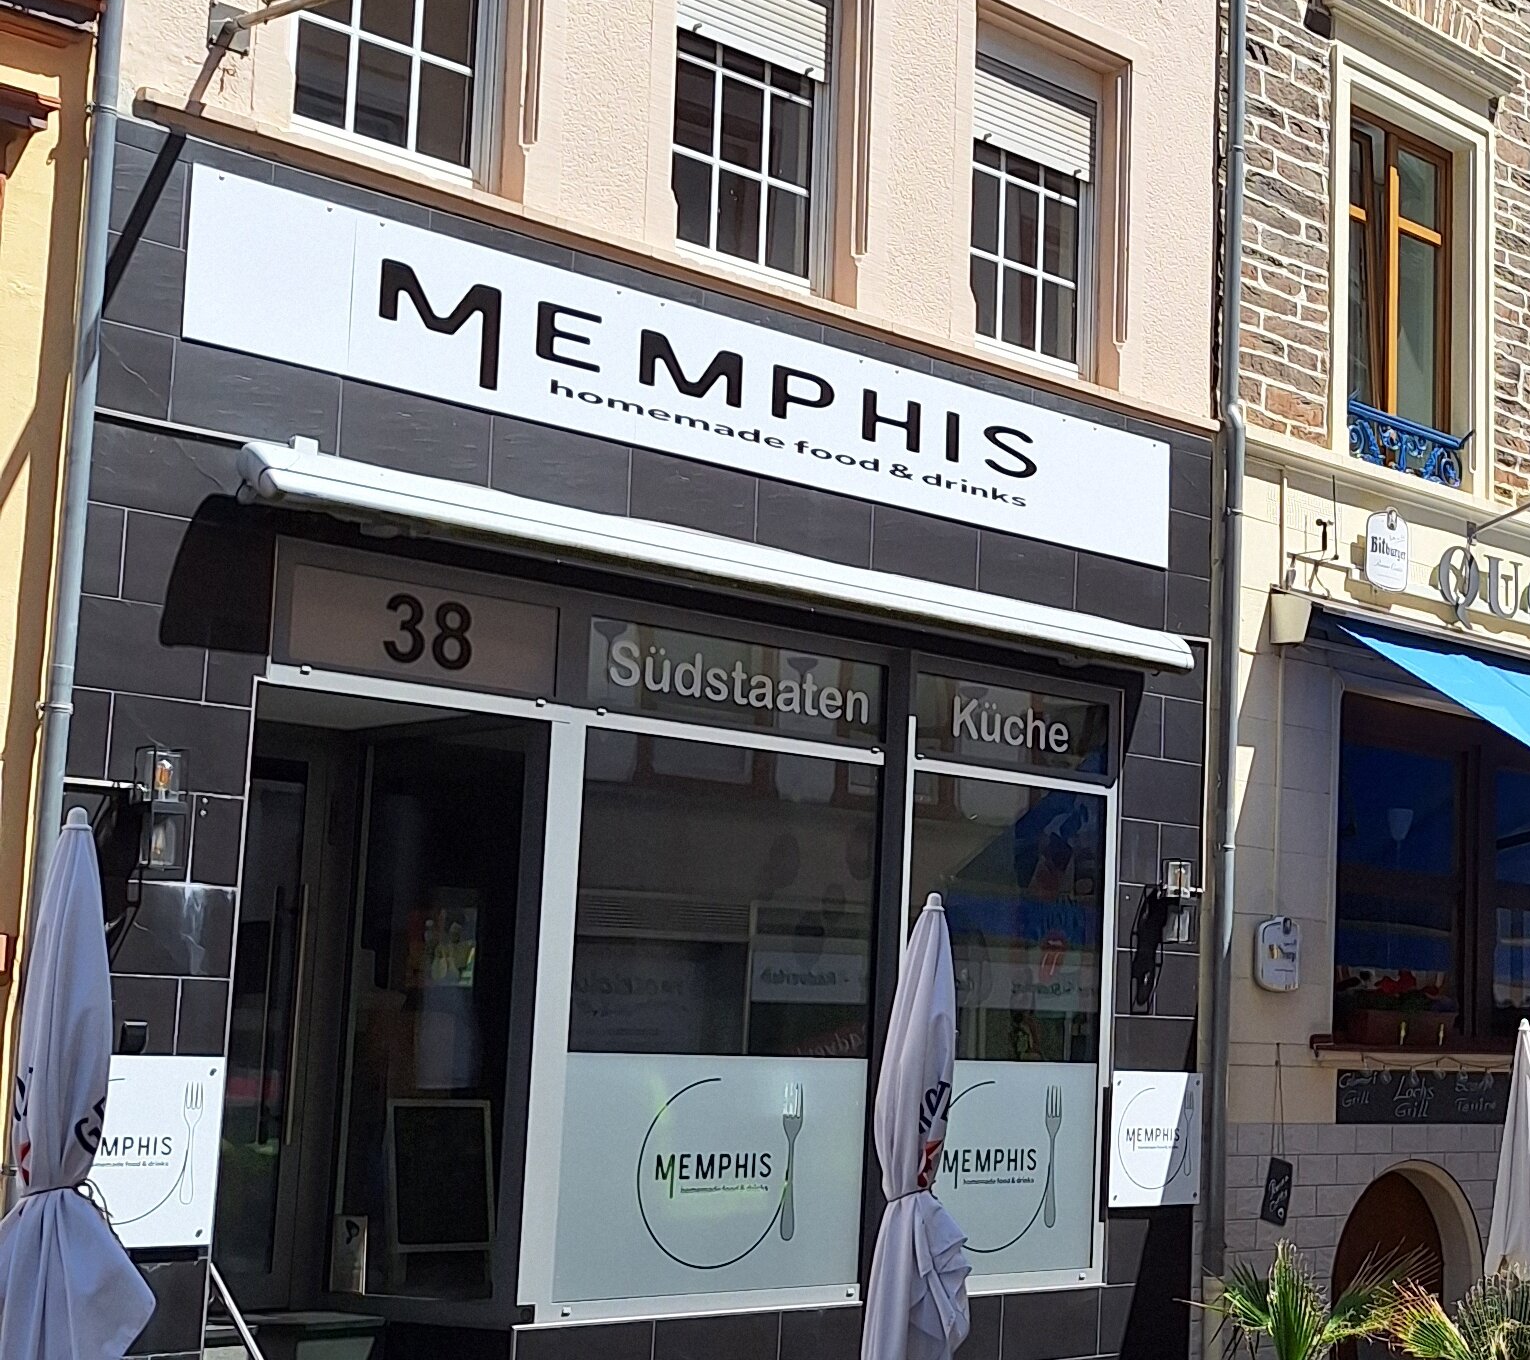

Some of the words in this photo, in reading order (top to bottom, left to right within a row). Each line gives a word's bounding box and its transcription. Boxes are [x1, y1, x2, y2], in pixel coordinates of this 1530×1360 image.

[379, 258, 1038, 479] MEMPHIS
[550, 379, 785, 450] homemade
[793, 440, 880, 473] food
[887, 462, 915, 481] &
[922, 471, 1027, 508] drinks
[383, 594, 473, 671] 38
[608, 638, 870, 725] Südstaaten
[952, 695, 1069, 753] Küche
[100, 1136, 173, 1156] MPHIS
[943, 1148, 1037, 1190] MEMPHIS
[1126, 1128, 1180, 1152] MEMPHIS
[655, 1153, 772, 1199] MEMPHIS
